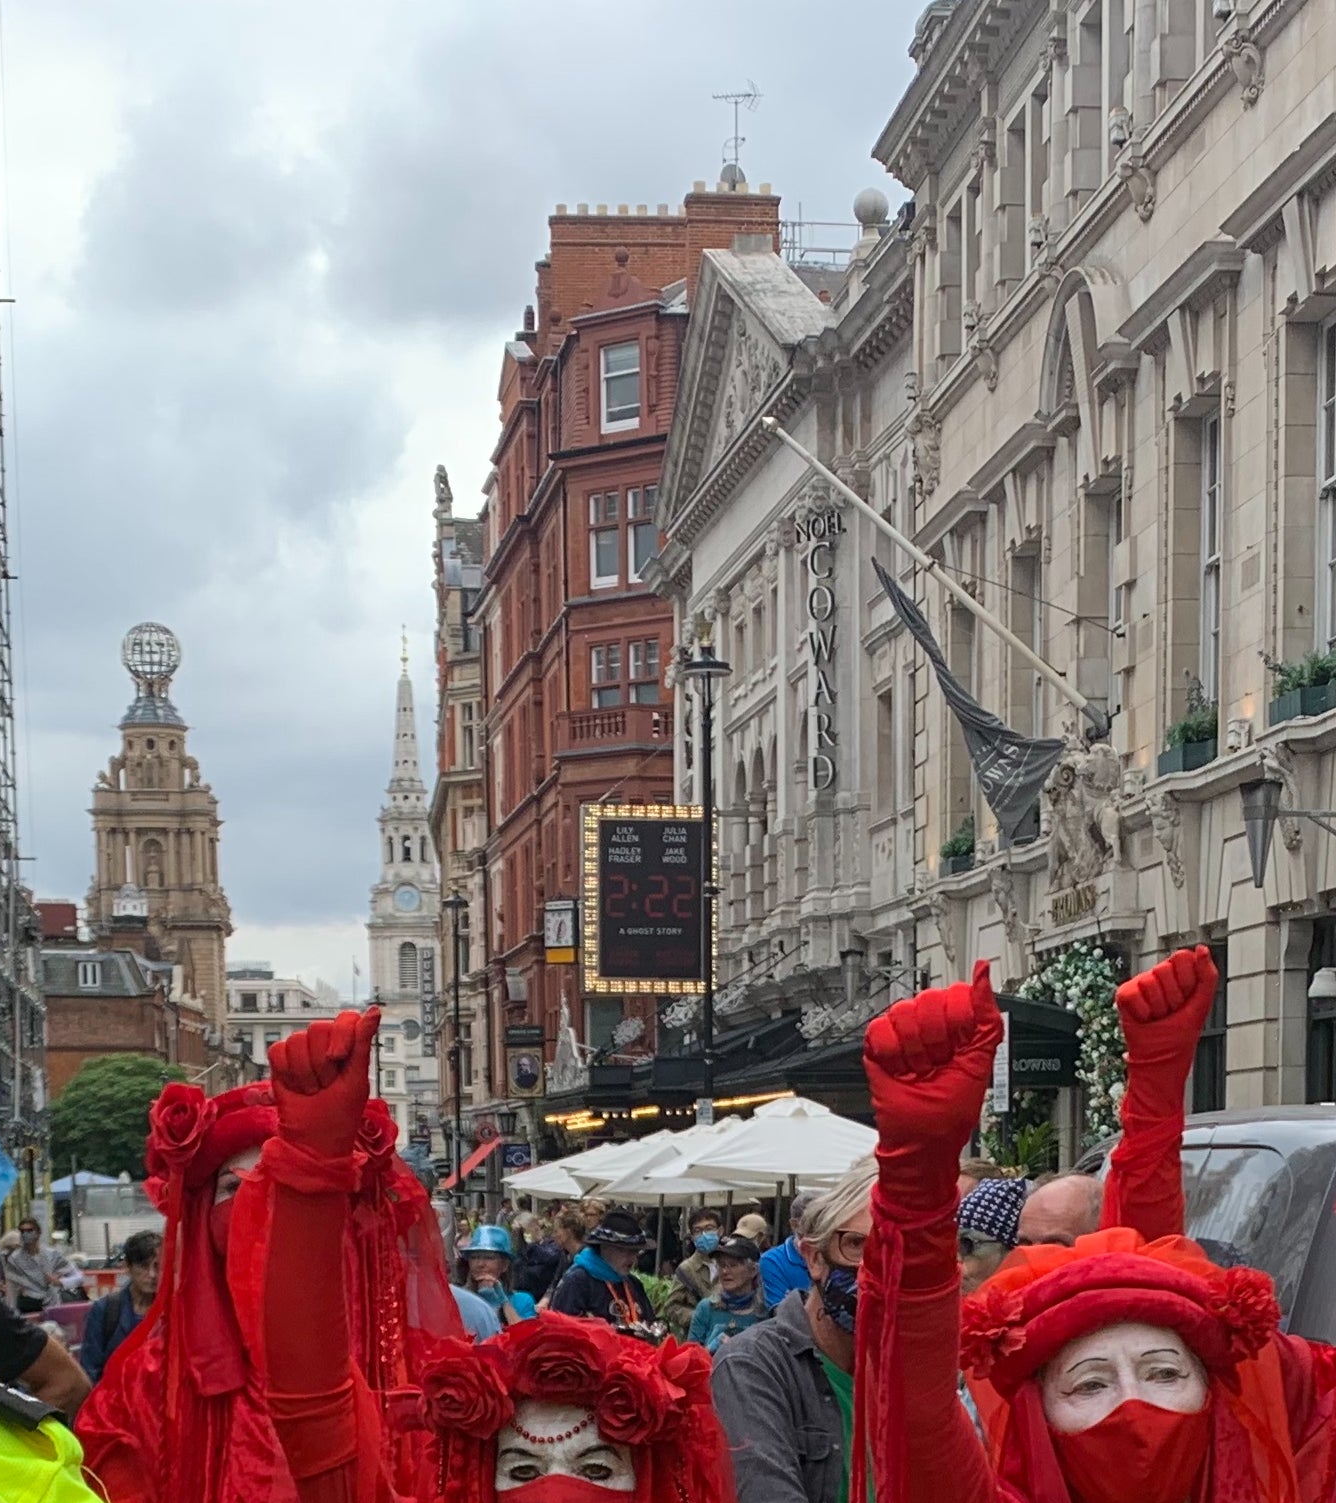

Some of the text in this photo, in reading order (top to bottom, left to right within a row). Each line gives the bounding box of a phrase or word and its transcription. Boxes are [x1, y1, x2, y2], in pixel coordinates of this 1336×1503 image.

[807, 540, 839, 792] COWARD
[616, 826, 634, 834] LILY
[663, 827, 687, 835] JULIA
[611, 834, 639, 843] ALLEN
[662, 835, 687, 843] CHAN
[608, 847, 641, 855] HADLEY
[664, 847, 685, 855] JAKE
[608, 855, 641, 863] FRASER
[662, 855, 687, 864] WOOD
[606, 875, 696, 918] 2:22
[619, 927, 682, 935] A GHOST STORY
